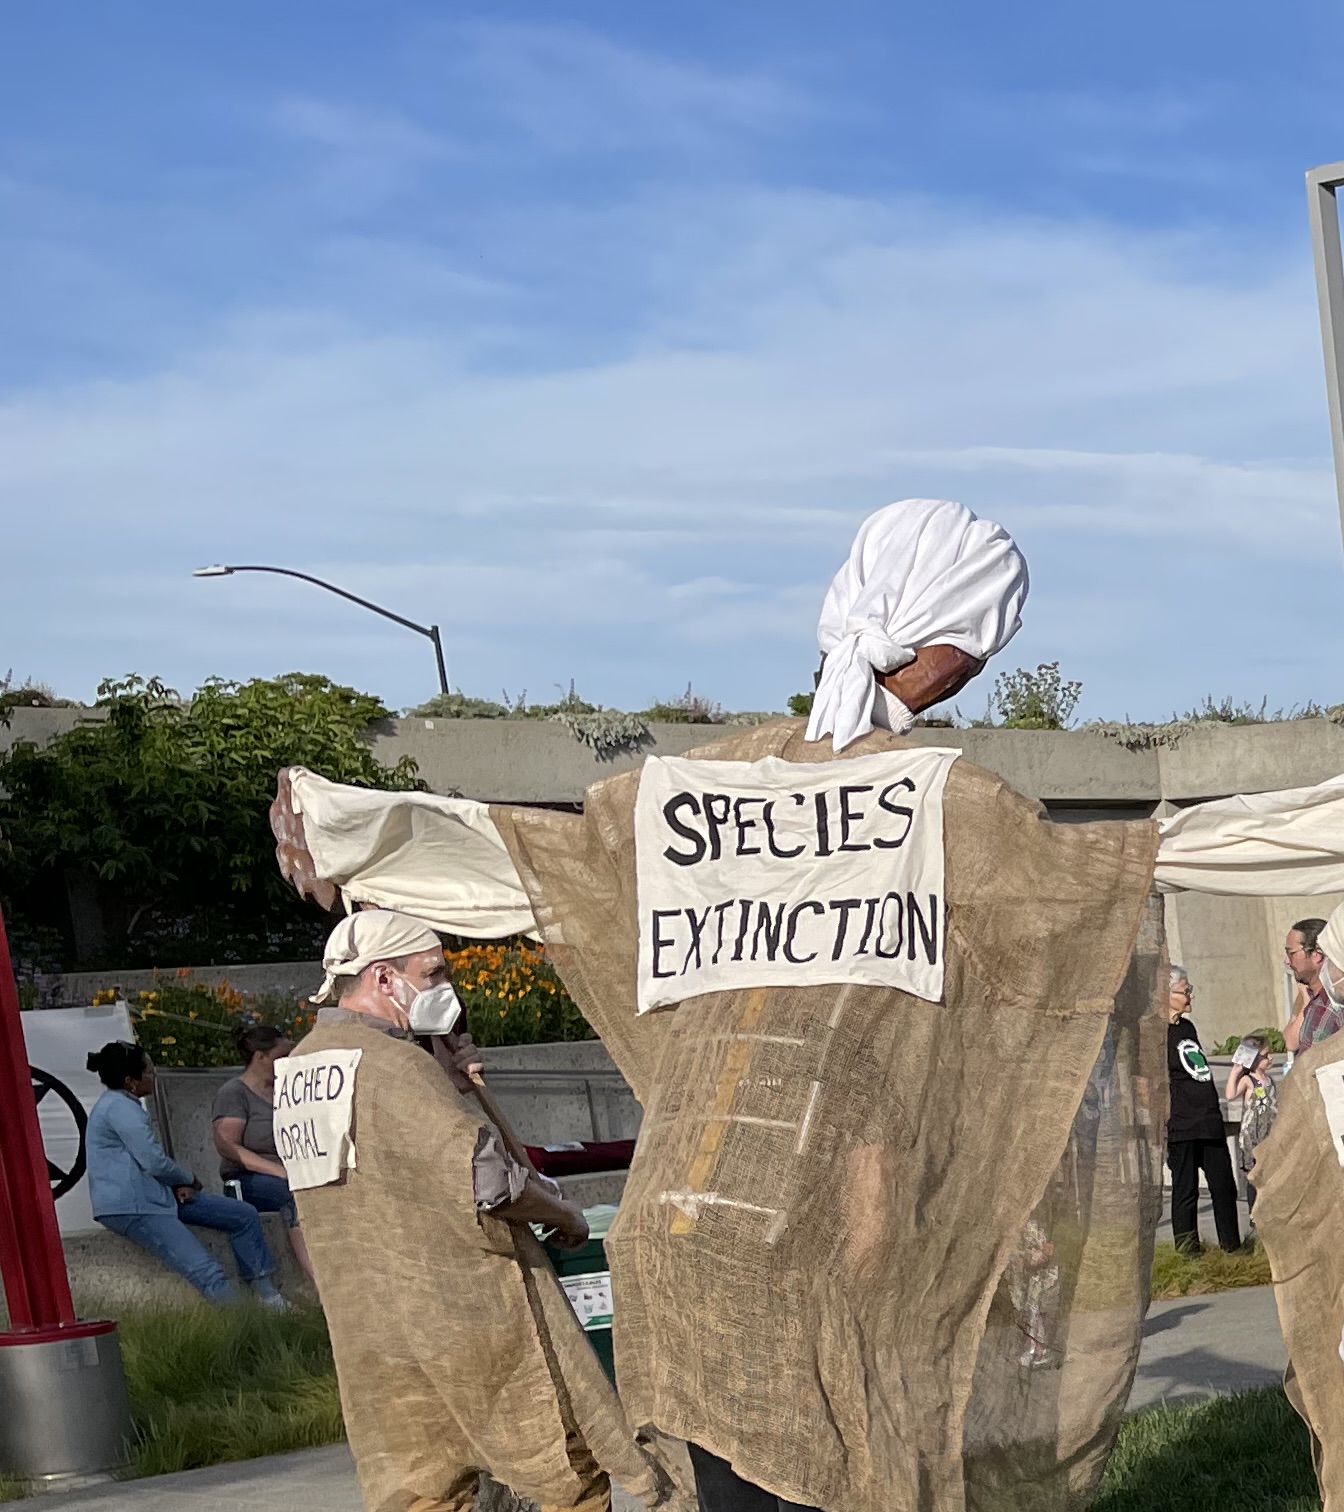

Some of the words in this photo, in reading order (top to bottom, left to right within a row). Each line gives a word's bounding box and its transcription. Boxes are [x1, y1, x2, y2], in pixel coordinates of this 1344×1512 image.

[663, 777, 917, 867] SPECIES
[652, 891, 937, 978] EXTINCTION
[273, 1065, 345, 1110] ACHED
[277, 1118, 327, 1161] ORAL
